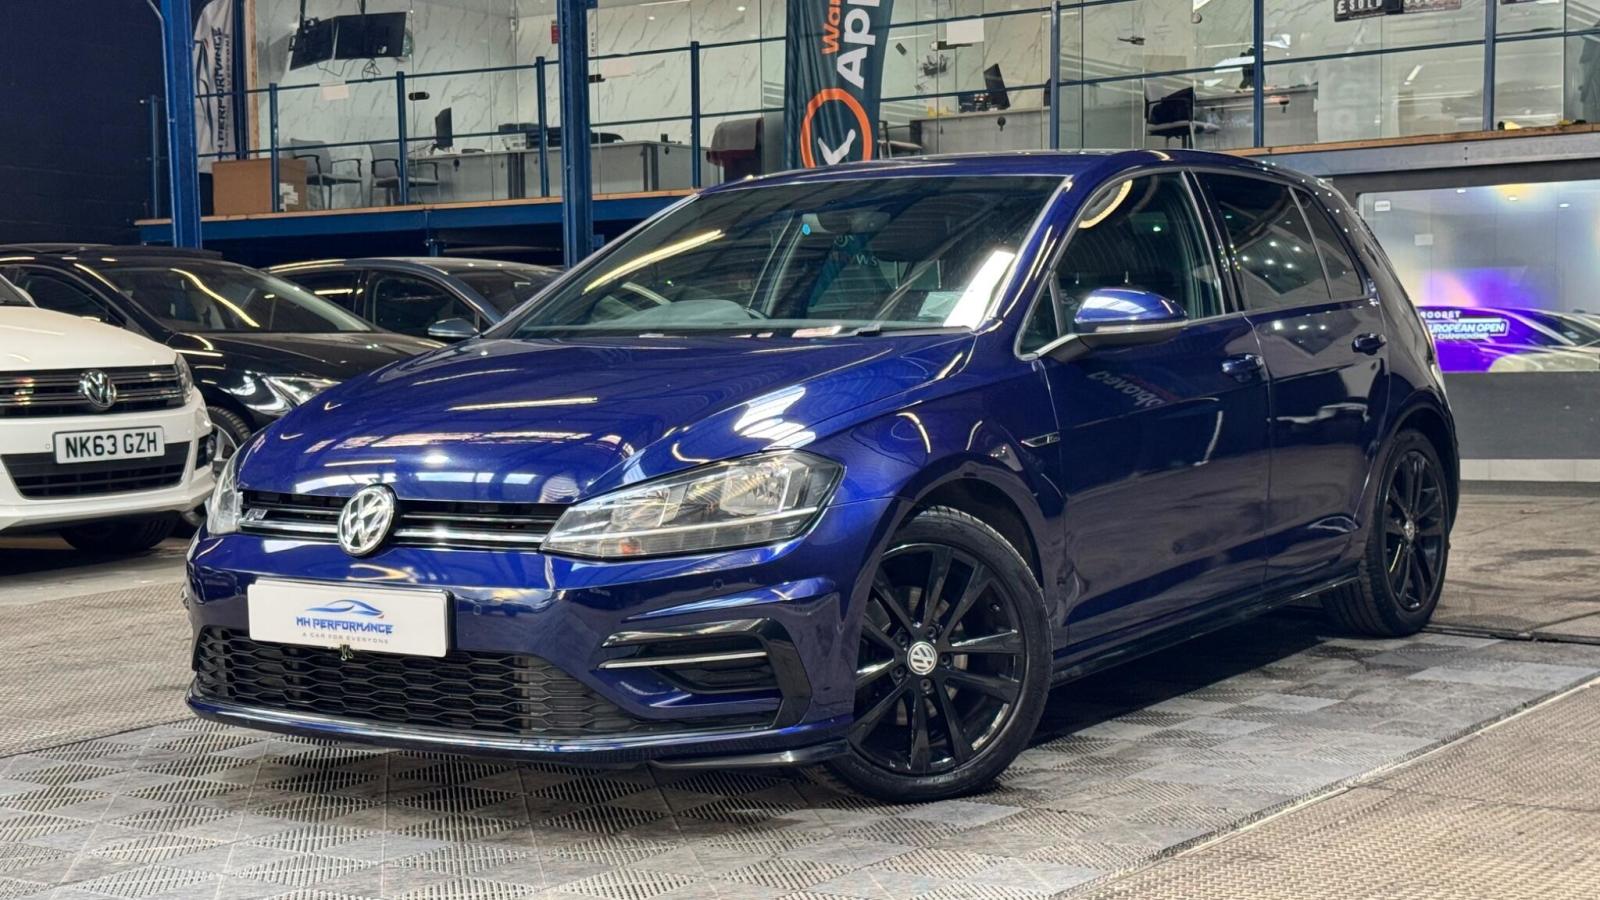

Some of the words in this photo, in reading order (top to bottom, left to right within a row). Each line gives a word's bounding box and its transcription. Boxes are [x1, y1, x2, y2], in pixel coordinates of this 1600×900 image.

[1427, 323, 1476, 333] UROPEAN
[1476, 322, 1506, 333] OPEN
[65, 434, 118, 459] NK63
[123, 432, 157, 455] GZH
[296, 616, 311, 627] MH
[312, 617, 394, 636] PERFORMANCE
